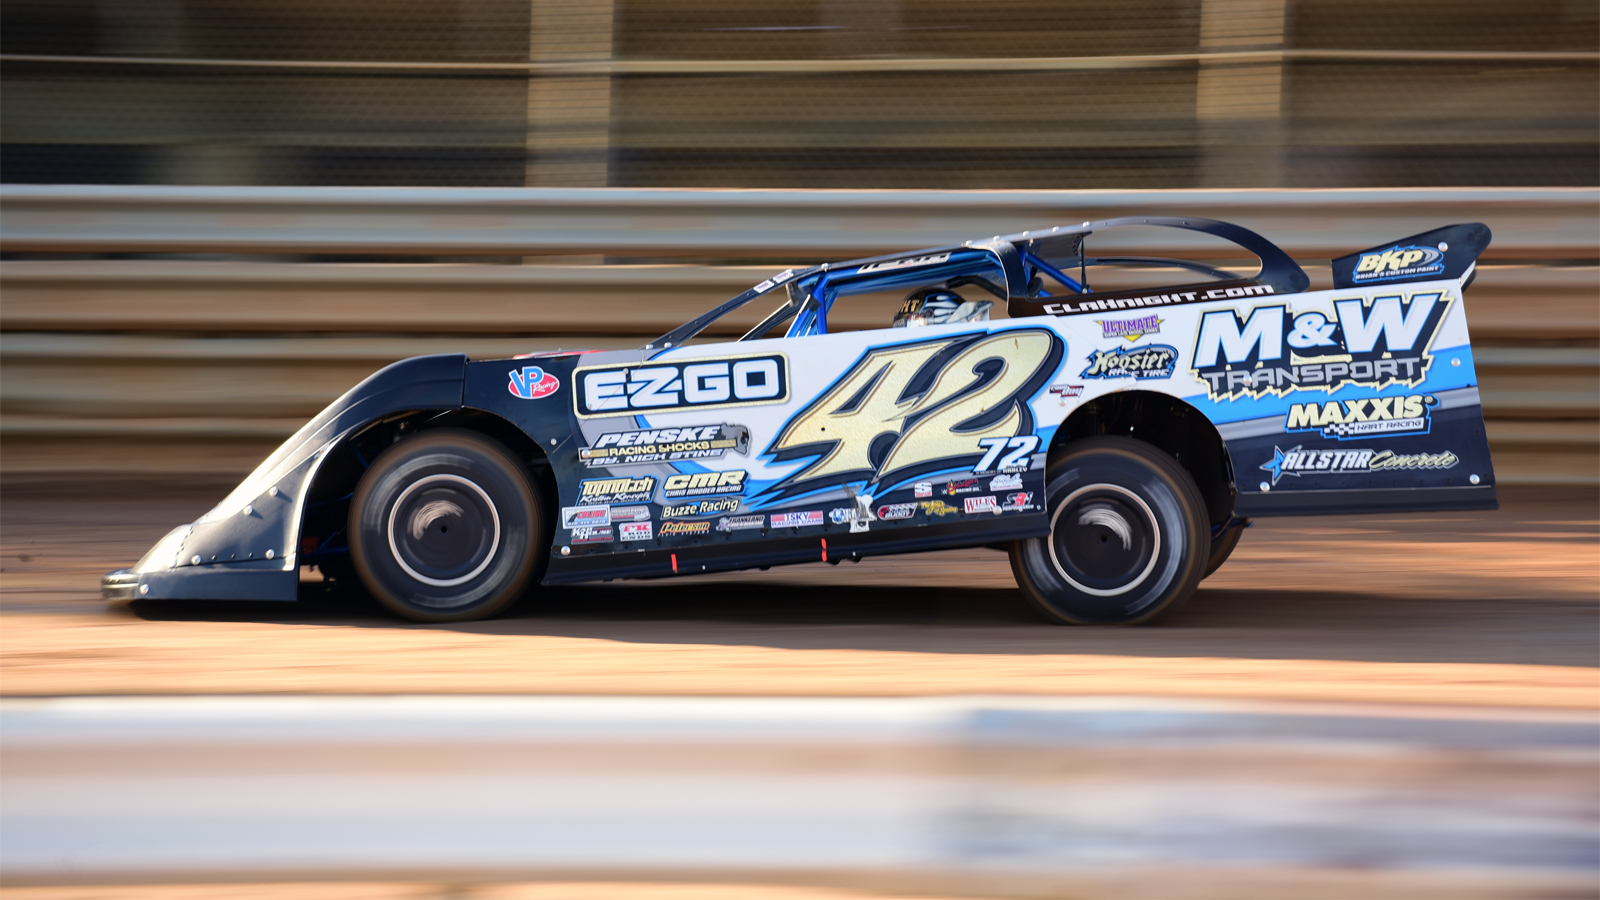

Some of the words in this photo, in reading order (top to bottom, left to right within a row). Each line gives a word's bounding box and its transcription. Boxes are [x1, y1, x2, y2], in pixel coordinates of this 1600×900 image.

[1356, 249, 1424, 273] BKP
[1417, 265, 1439, 273] PAINT
[1102, 315, 1158, 333] ULTIMATE
[1193, 293, 1442, 368] M&W
[1086, 348, 1170, 375] Hoosier
[509, 366, 545, 398] VP
[1143, 368, 1170, 377] TIRE
[1202, 357, 1420, 392] TRANSPORT
[533, 380, 558, 394] Racing
[584, 358, 780, 411] EZGO
[772, 330, 1054, 484] 42
[1357, 422, 1385, 431] KART
[1387, 419, 1422, 429] RACING
[595, 425, 721, 448] PENSKE
[609, 445, 656, 457] RACING
[625, 453, 667, 463] NICK
[669, 448, 724, 459] STINE
[973, 435, 1039, 472] 72
[1280, 450, 1374, 470] ALLSTAR
[1368, 451, 1459, 470] Concrete
[663, 470, 745, 490] CMR
[665, 489, 686, 497] CHRIS
[716, 484, 742, 494] RACING
[577, 509, 606, 519] CRUISE
[662, 503, 698, 518] Buzze
[699, 499, 739, 514] Racing
[785, 511, 811, 521] ISKY
[660, 521, 710, 534] Peterson
